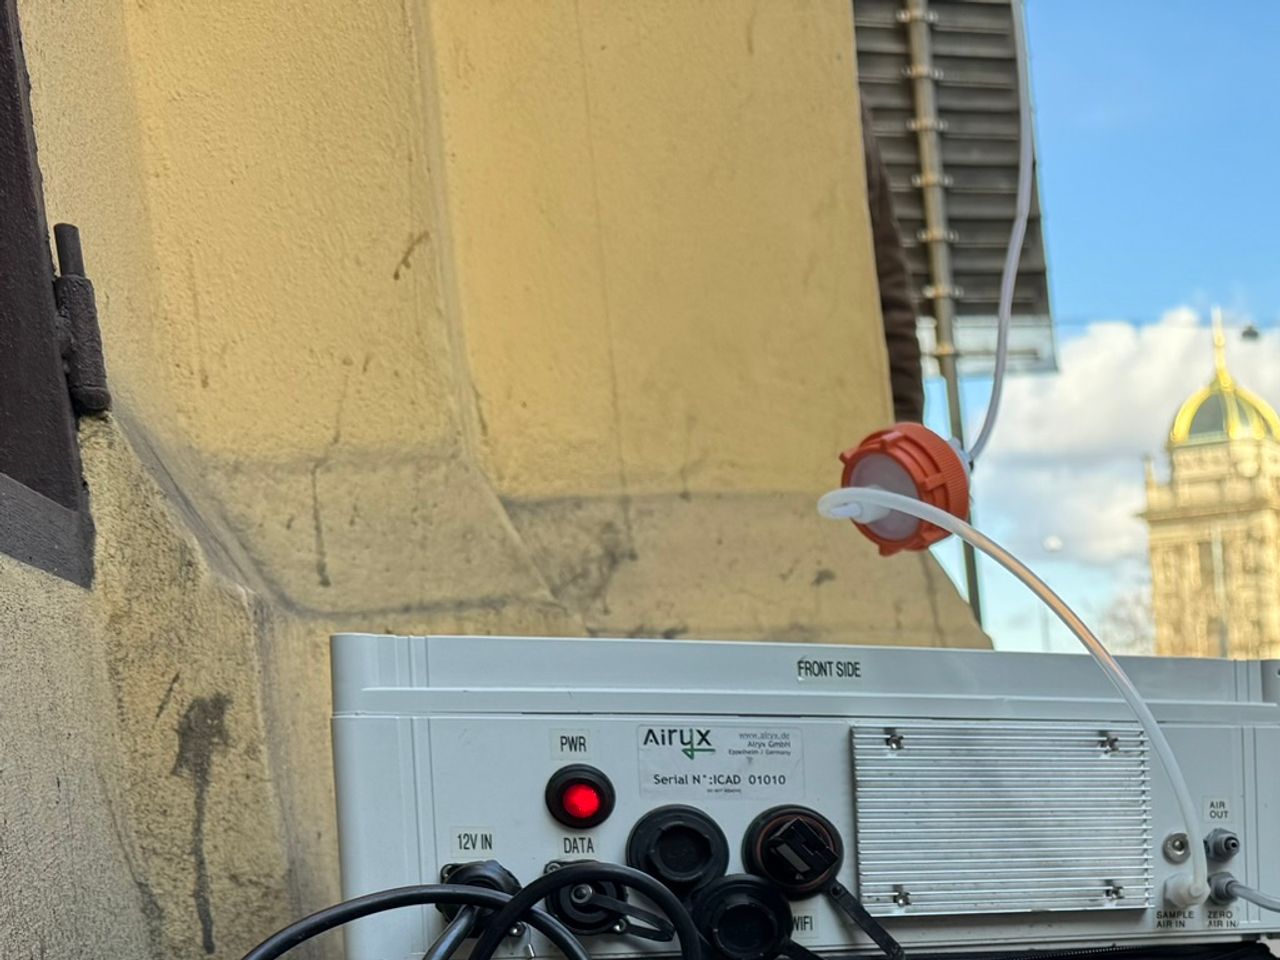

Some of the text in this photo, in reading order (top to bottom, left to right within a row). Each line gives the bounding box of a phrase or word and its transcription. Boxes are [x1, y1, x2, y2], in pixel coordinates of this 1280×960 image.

[797, 660, 861, 677] FRONT SIDE
[560, 735, 587, 752] PWR
[643, 728, 715, 759] Airyx
[653, 774, 688, 785] Serial
[748, 774, 786, 785] 01010
[1209, 801, 1225, 809] AIR
[1209, 811, 1228, 819] OUT
[457, 833, 493, 850] 12V IN
[563, 837, 595, 854] DATA
[1156, 911, 1195, 919] SAMPLE
[1207, 911, 1233, 919] ZERO
[1156, 920, 1185, 928] AIR IN
[1207, 920, 1223, 928] AIR
